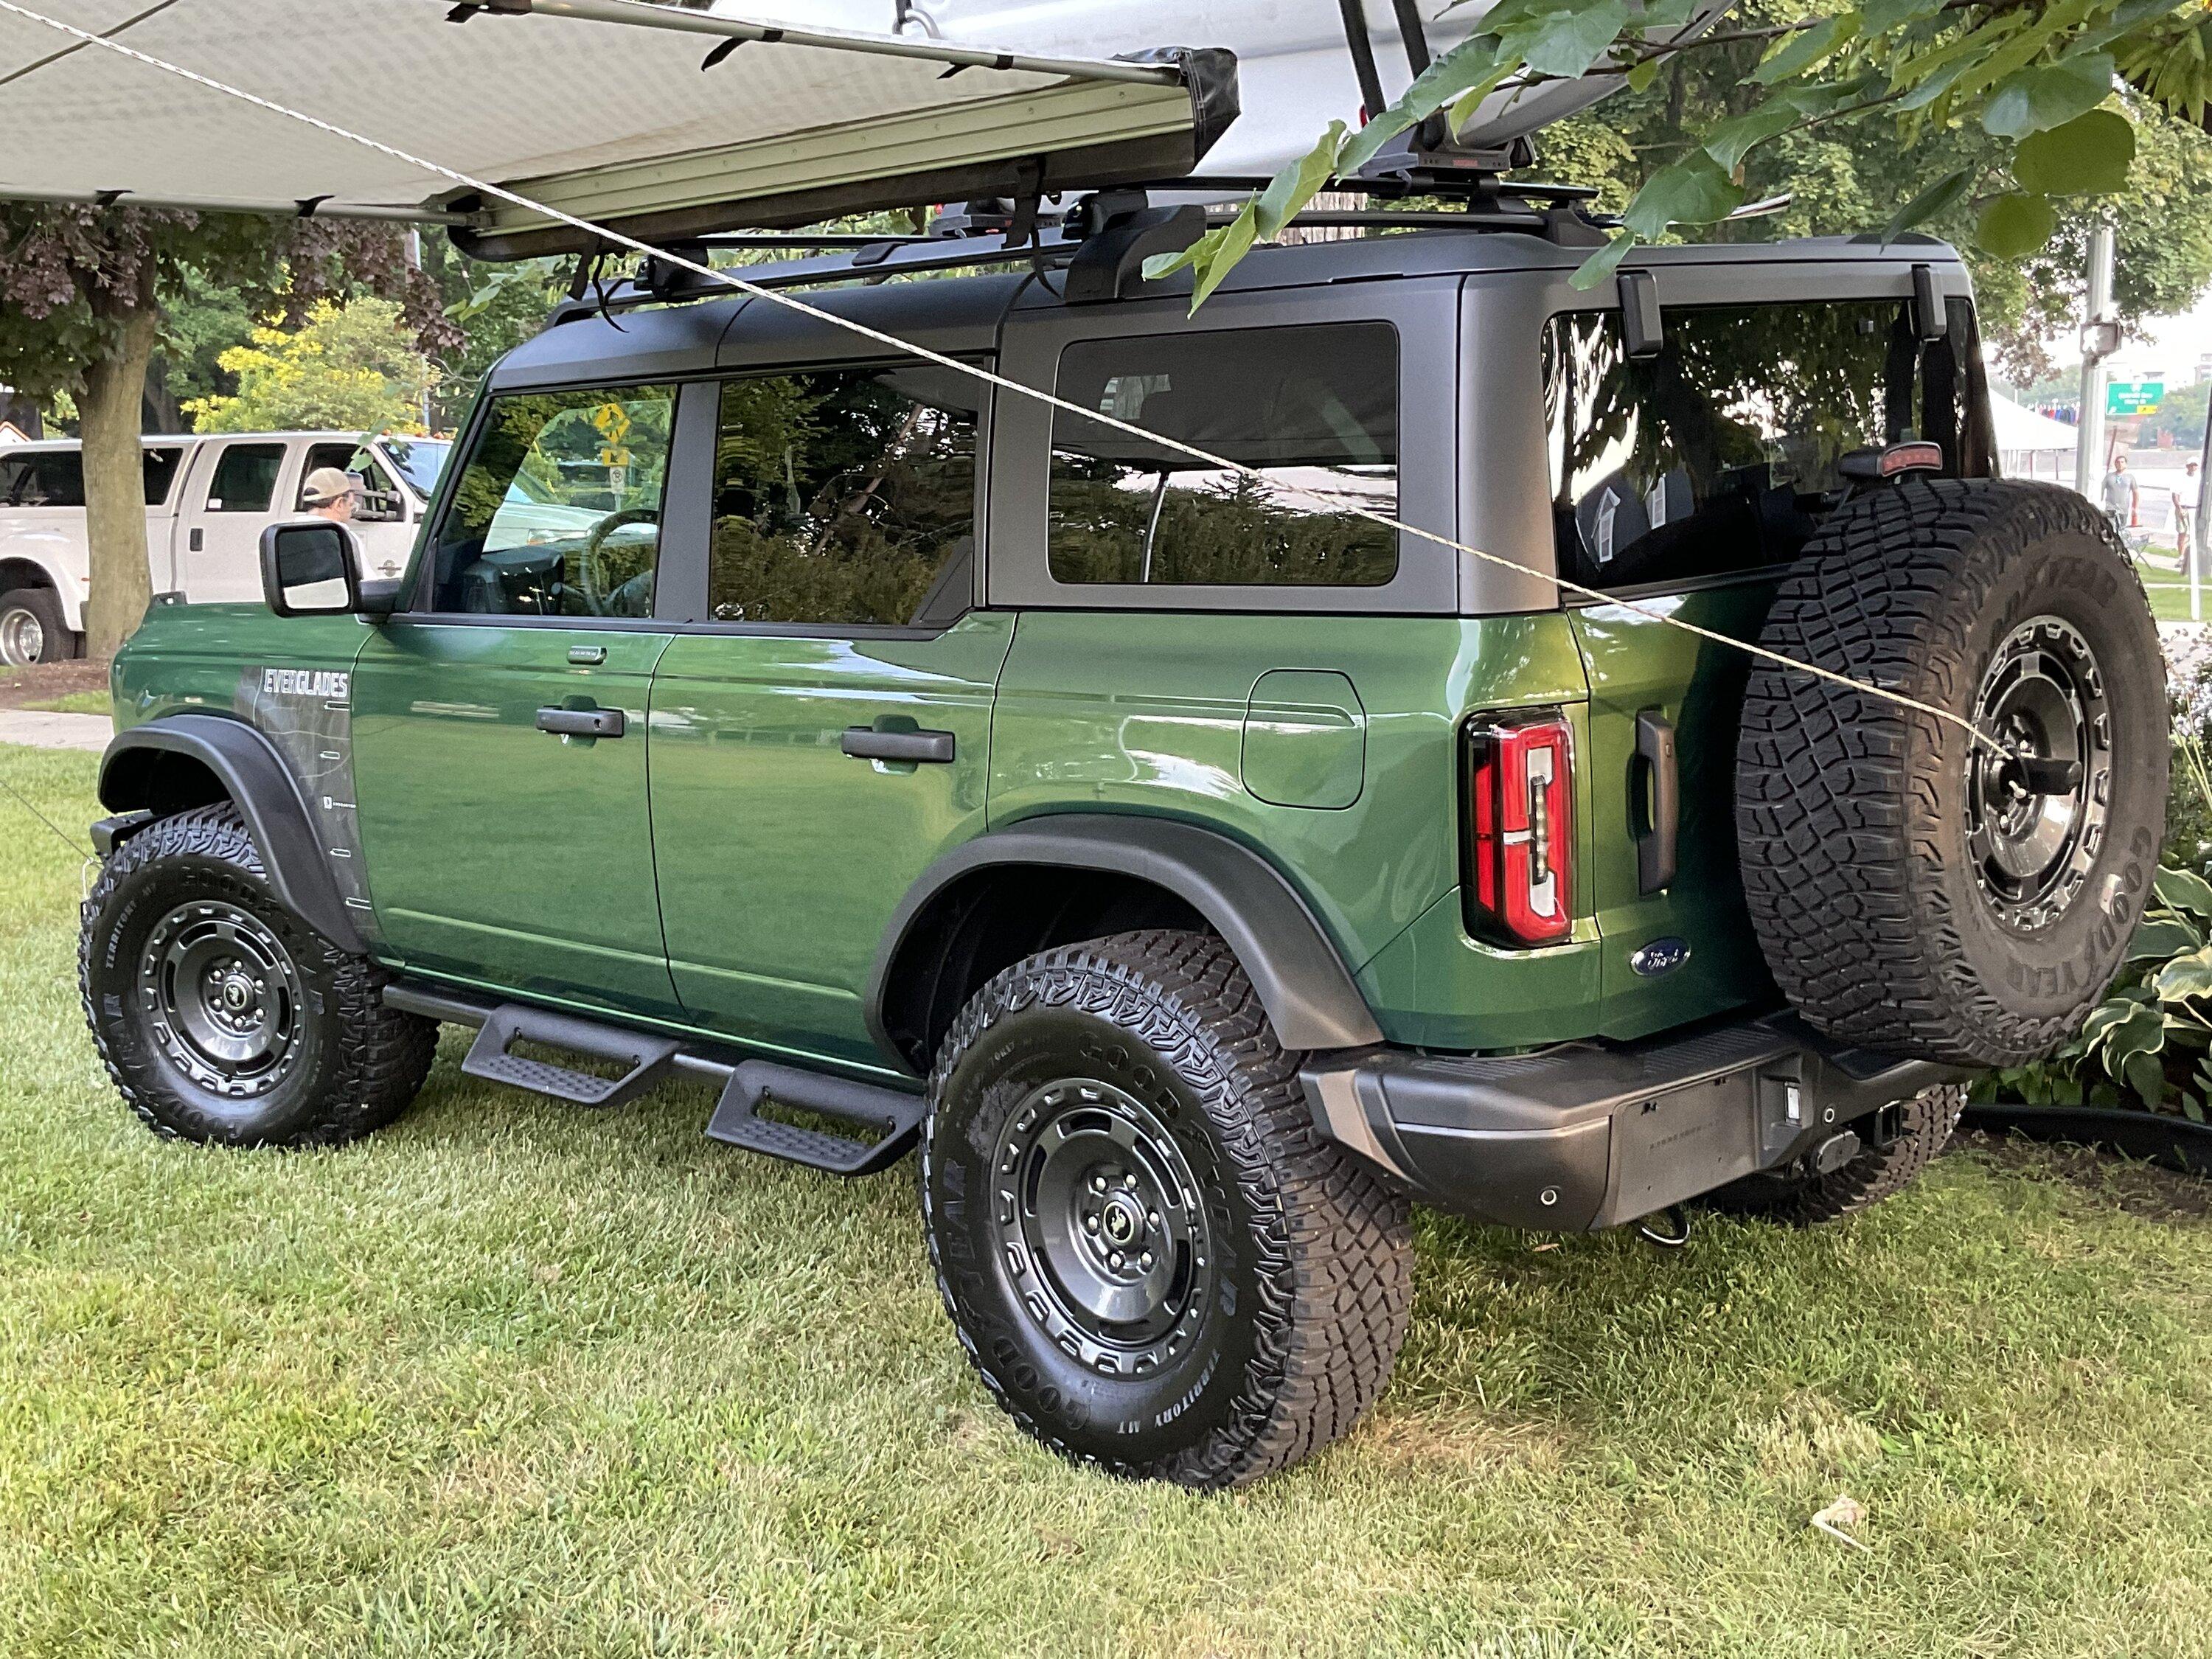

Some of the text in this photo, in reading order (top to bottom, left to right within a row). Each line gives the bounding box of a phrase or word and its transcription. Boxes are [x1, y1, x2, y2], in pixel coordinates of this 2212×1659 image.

[264, 669, 348, 698] EVERGLADES
[105, 896, 137, 970] TERRITORY
[1154, 1348, 1221, 1429] TERRITORY
